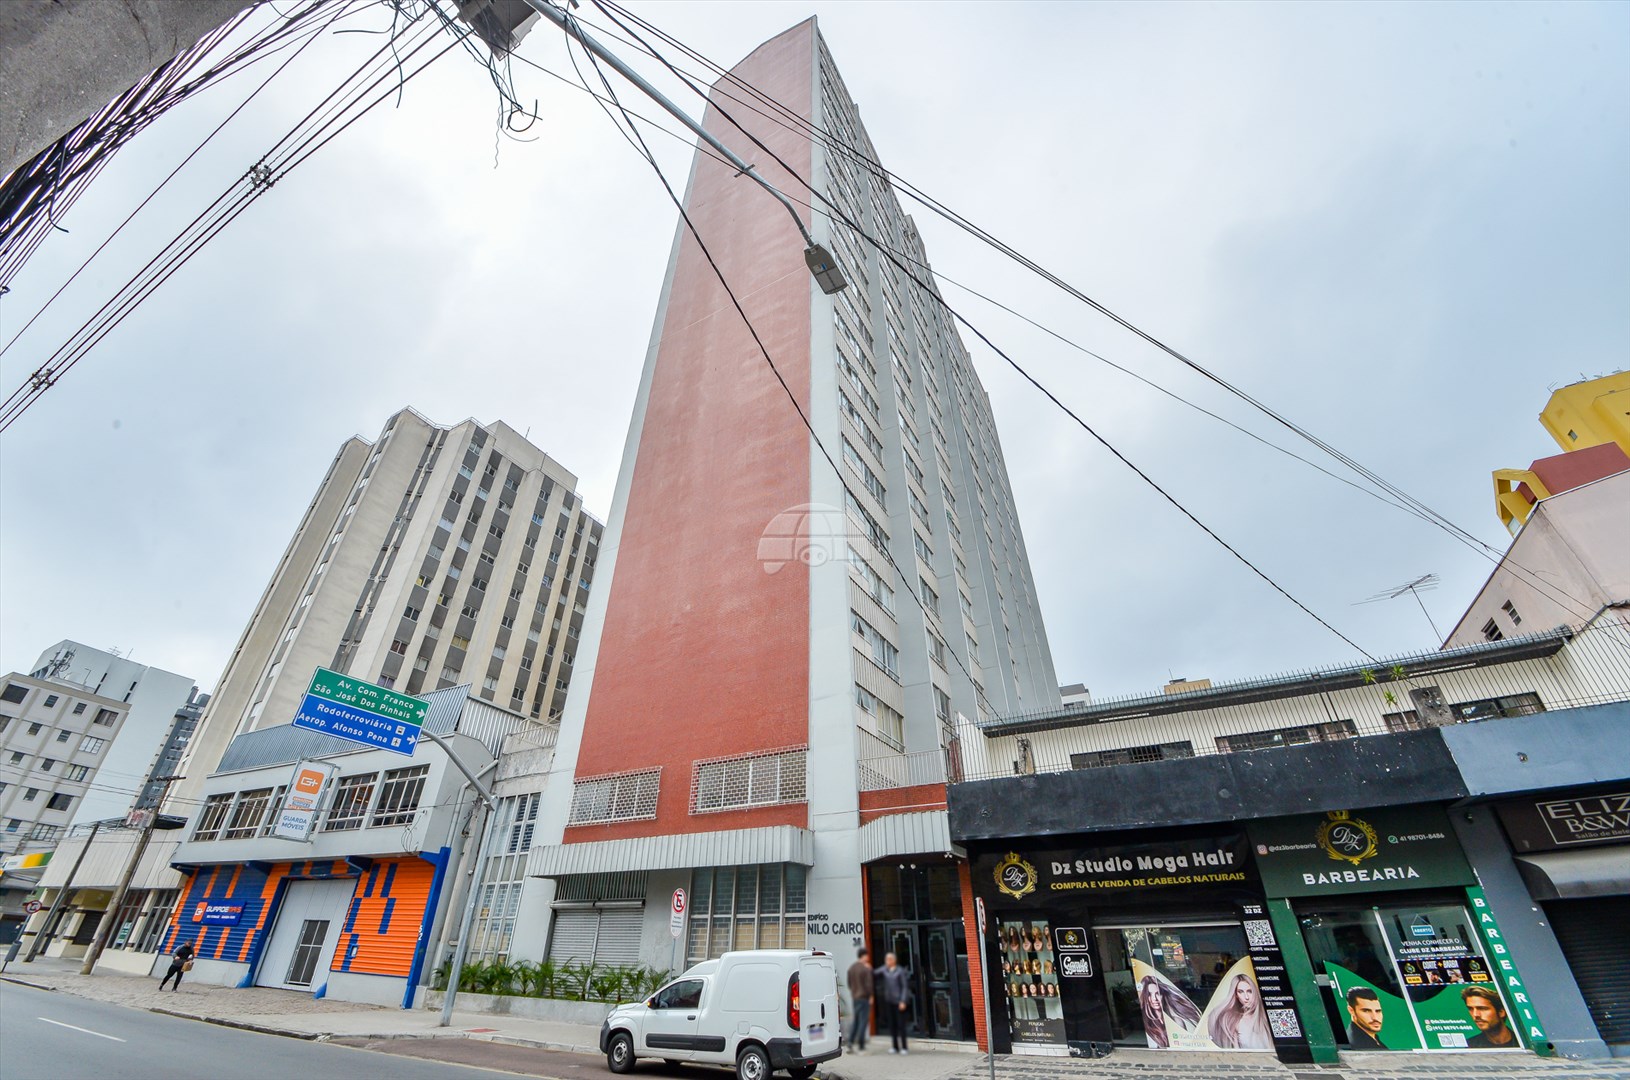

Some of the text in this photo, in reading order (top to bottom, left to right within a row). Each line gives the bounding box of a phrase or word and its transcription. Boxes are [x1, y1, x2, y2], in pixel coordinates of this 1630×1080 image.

[314, 683, 411, 719] São José Dos Pinhais
[337, 680, 414, 709] Av. Com. Franco
[316, 704, 392, 731] Rodoferroviária
[297, 712, 388, 743] Aerop. Afonso Pena
[281, 822, 304, 831] MÓVEIS
[283, 815, 307, 824] GUARDA
[1051, 849, 1234, 875] Dz Studio Mega Hair
[1050, 881, 1089, 890] COMPRA
[1097, 879, 1131, 888] VENDA
[1147, 875, 1192, 885] CABELOS
[1193, 872, 1246, 882] NATURAIS
[1303, 866, 1420, 885] BARBEARIA
[808, 922, 863, 935] NILO CAIRO
[1422, 938, 1454, 946] CONHECER
[1431, 945, 1468, 953] BARBEARIA
[1473, 898, 1543, 1038] BARBEARIA
